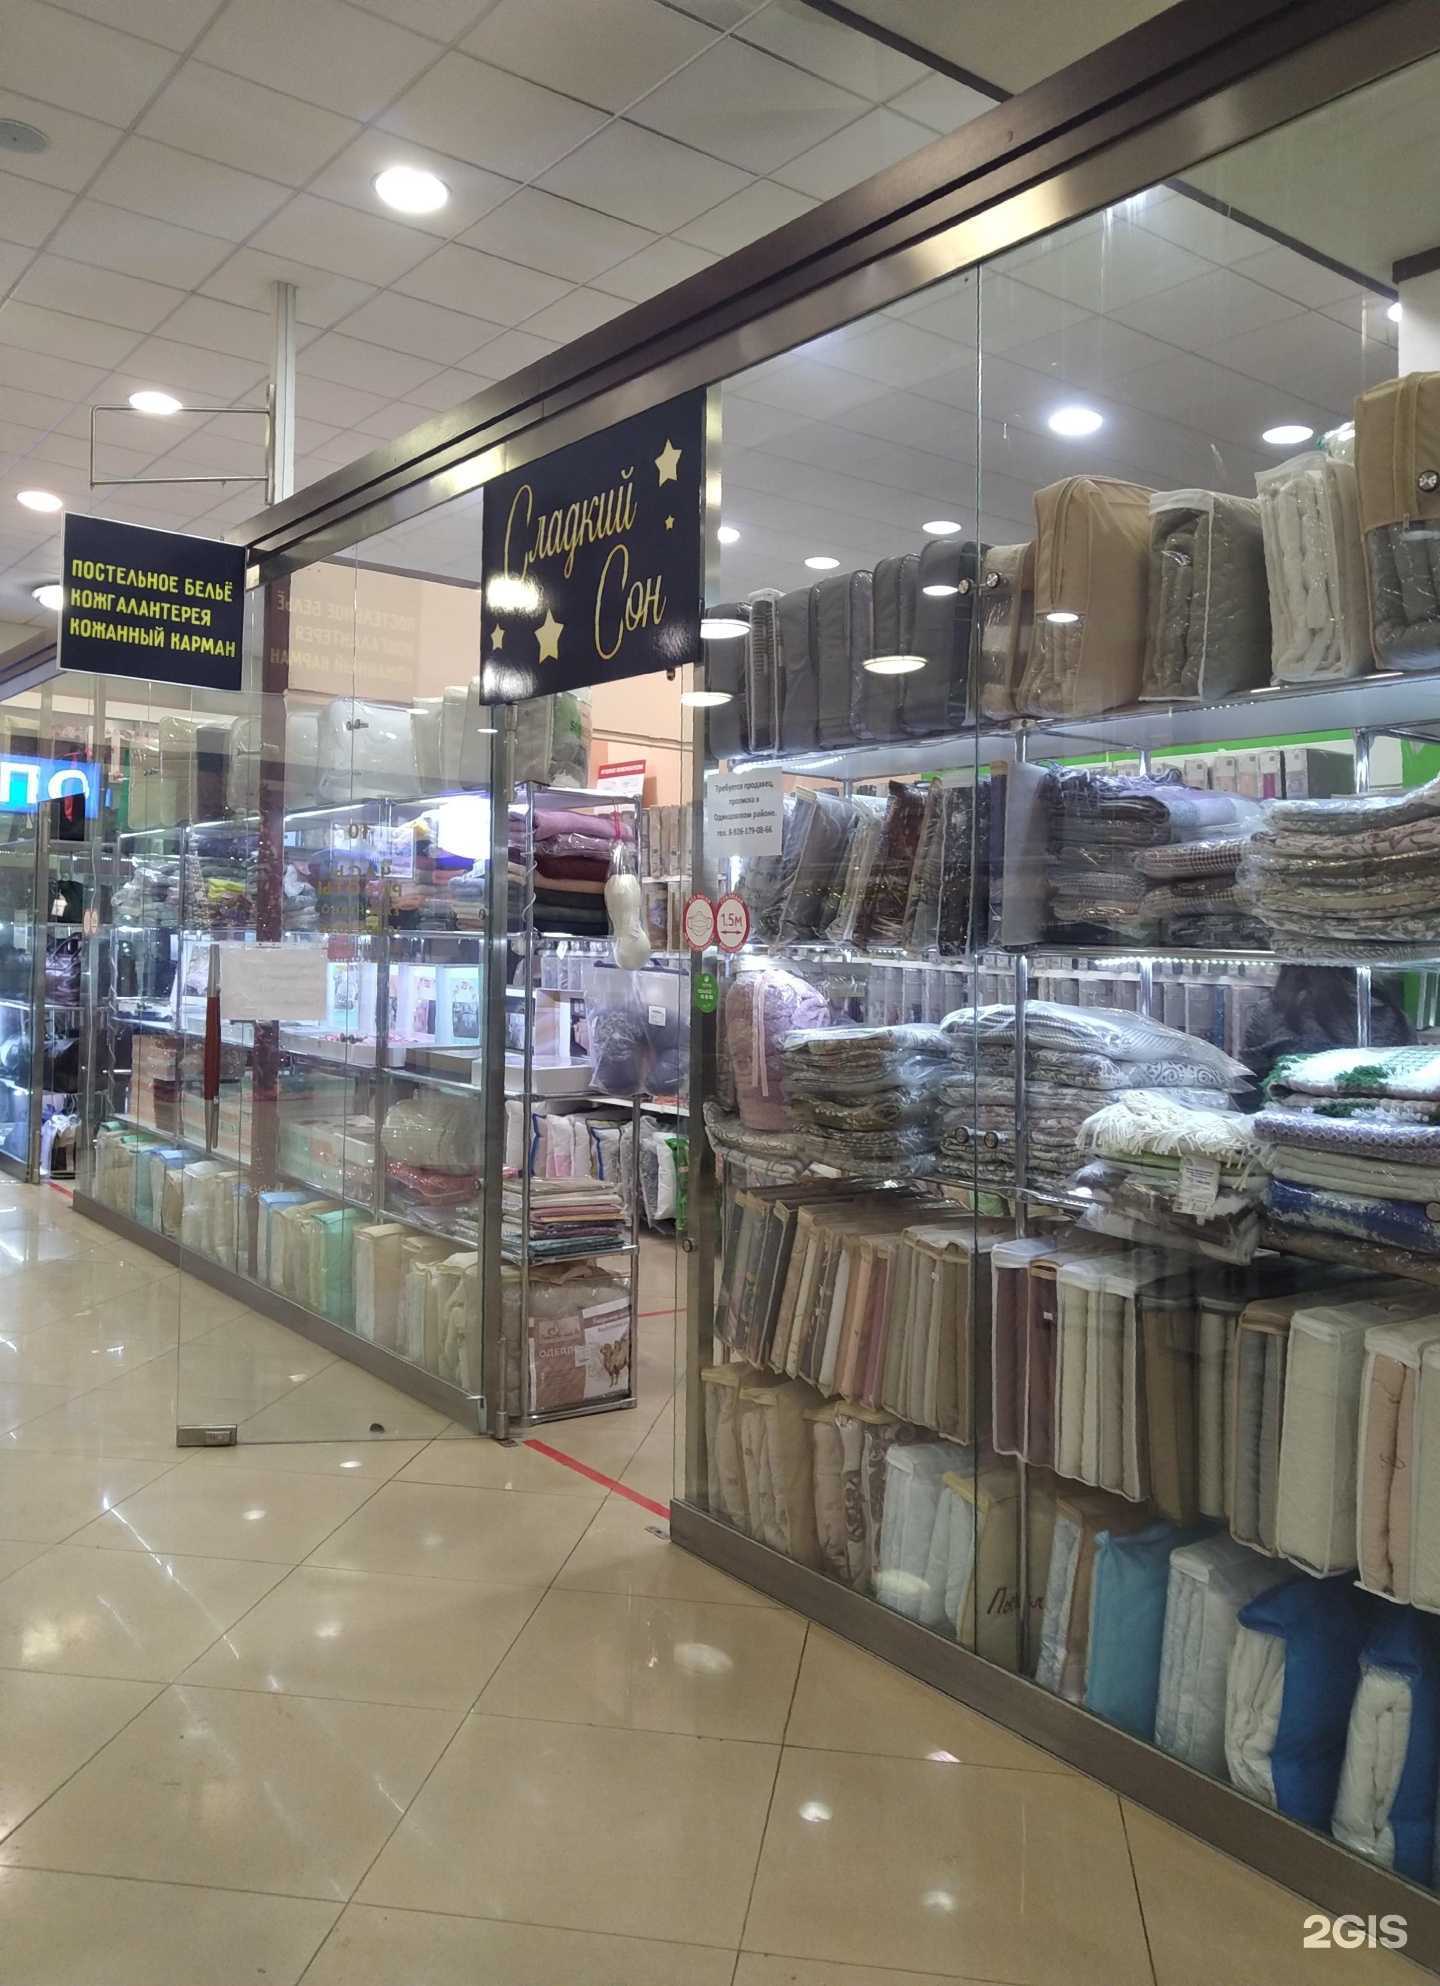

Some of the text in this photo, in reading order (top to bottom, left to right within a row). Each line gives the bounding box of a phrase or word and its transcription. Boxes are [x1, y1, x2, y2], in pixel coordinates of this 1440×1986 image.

[504, 466, 638, 584] Сладкий
[71, 558, 234, 603] ПОСТЕЛЬНОЕ БЕЛЬЁ
[594, 543, 667, 660] Сон
[69, 617, 236, 659] КОЖАННЫЙ КАРМАН
